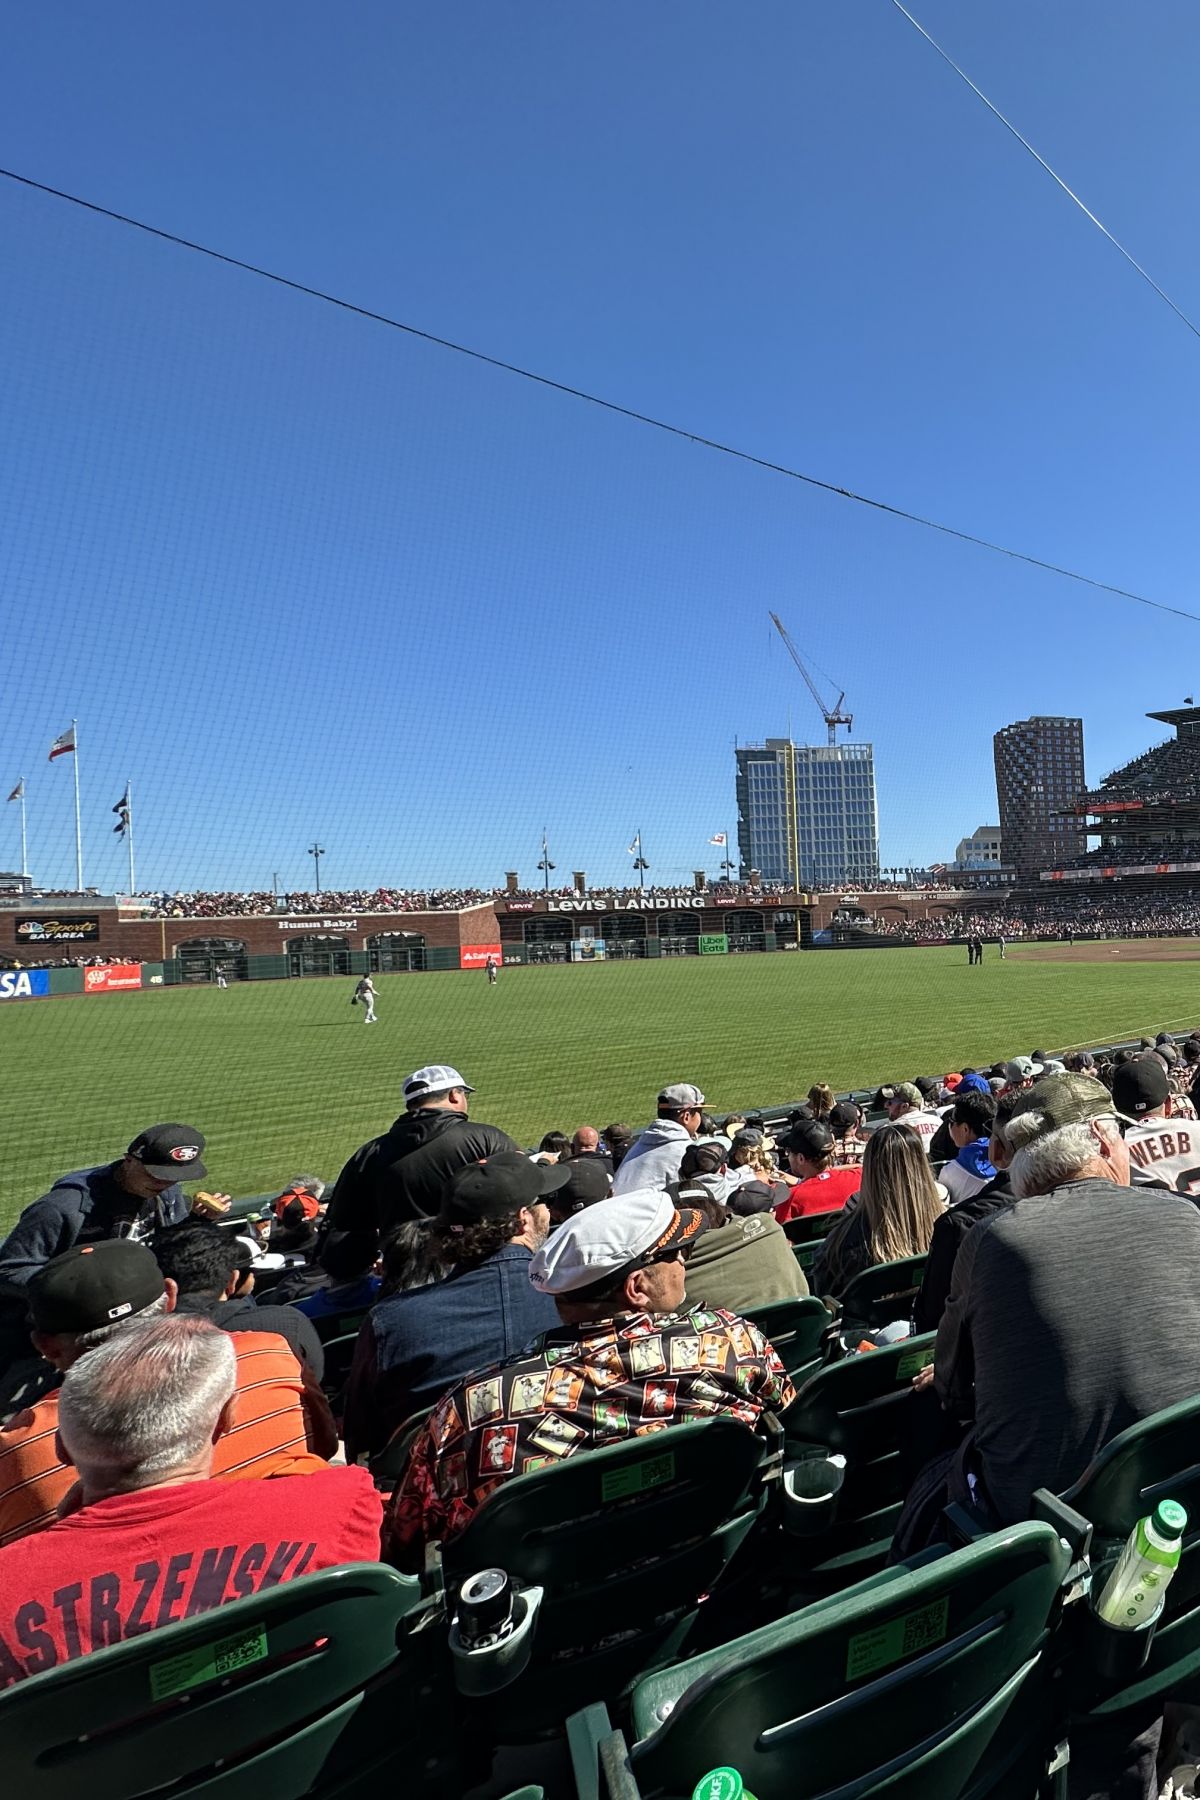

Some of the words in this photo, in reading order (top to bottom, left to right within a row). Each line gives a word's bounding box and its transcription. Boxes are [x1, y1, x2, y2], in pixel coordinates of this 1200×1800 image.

[614, 897, 705, 910] LANDING
[43, 921, 97, 933] Sports
[278, 921, 321, 929] Humm
[323, 919, 357, 929] Baby!
[702, 937, 724, 945] Uber
[504, 955, 521, 963] 365
[0, 972, 32, 998] SA
[150, 975, 163, 984] 415
[1128, 1131, 1191, 1169] WEBB
